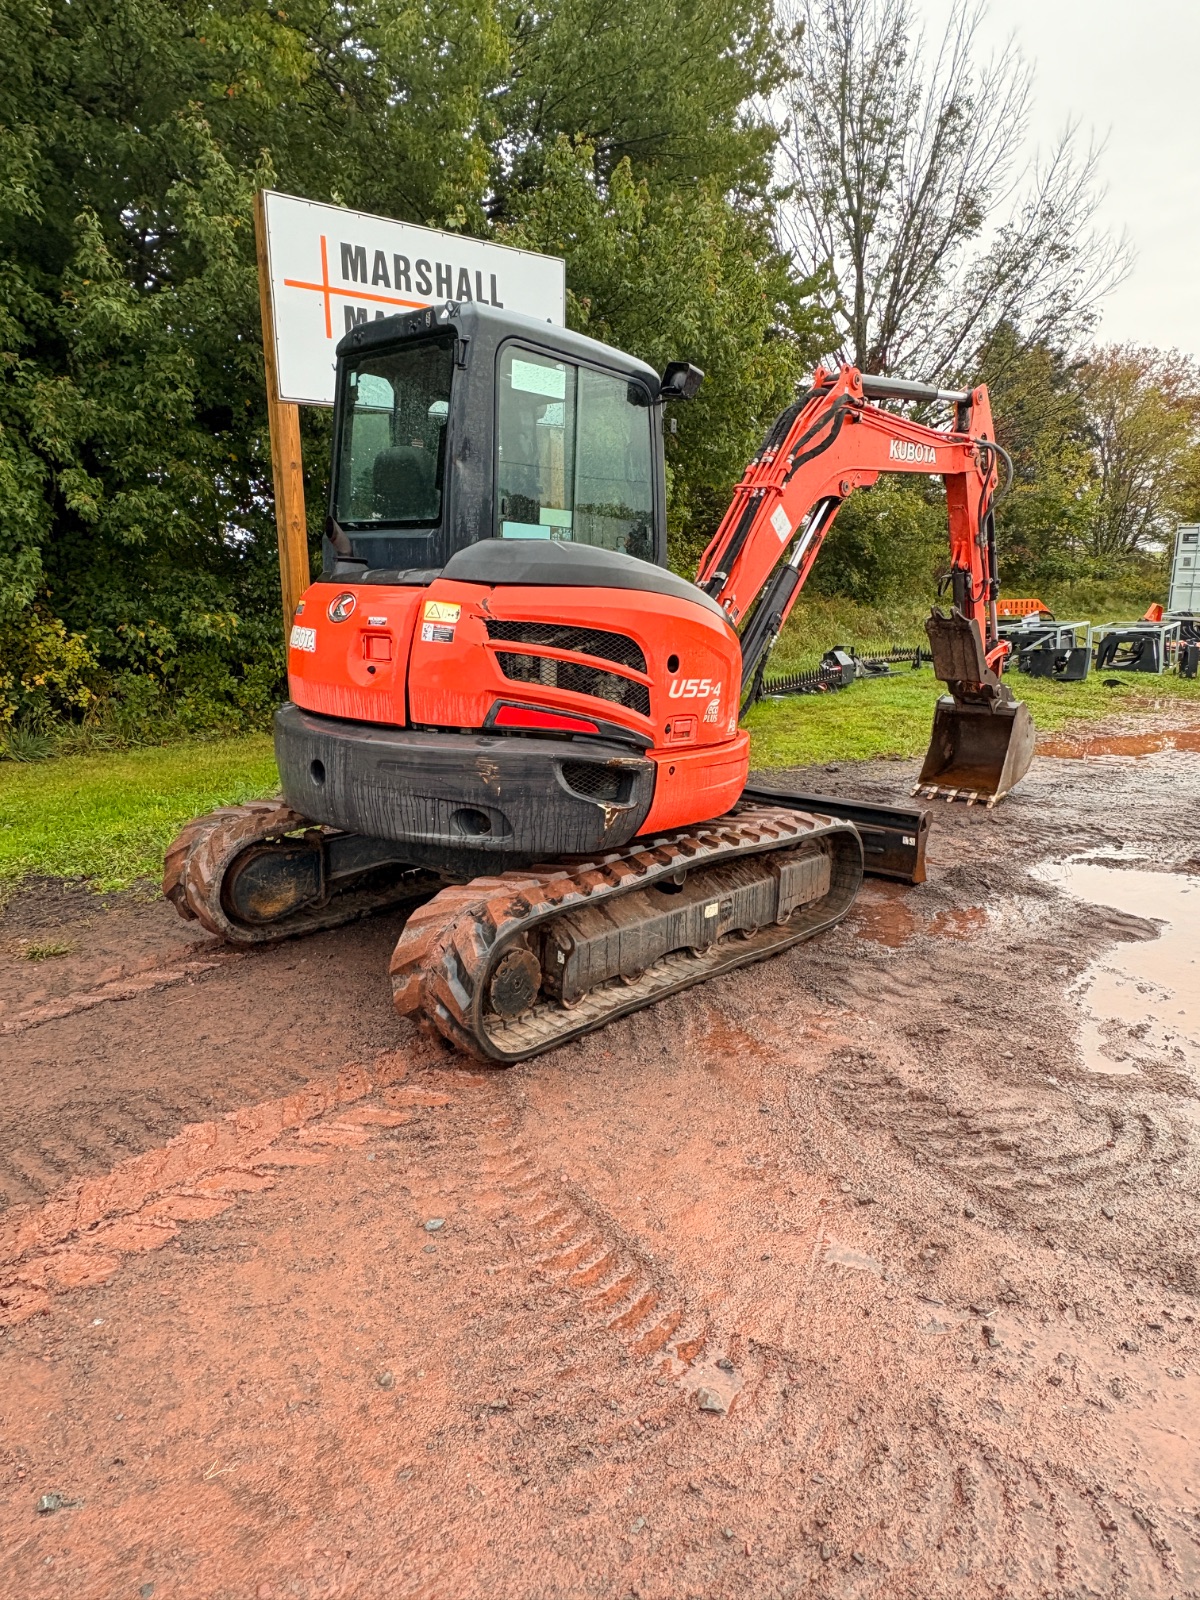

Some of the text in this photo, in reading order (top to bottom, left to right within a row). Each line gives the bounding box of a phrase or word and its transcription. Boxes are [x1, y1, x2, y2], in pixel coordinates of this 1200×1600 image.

[340, 242, 504, 309] MARSHALL
[889, 440, 937, 464] KUBOTA
[668, 678, 722, 698] U55-4
